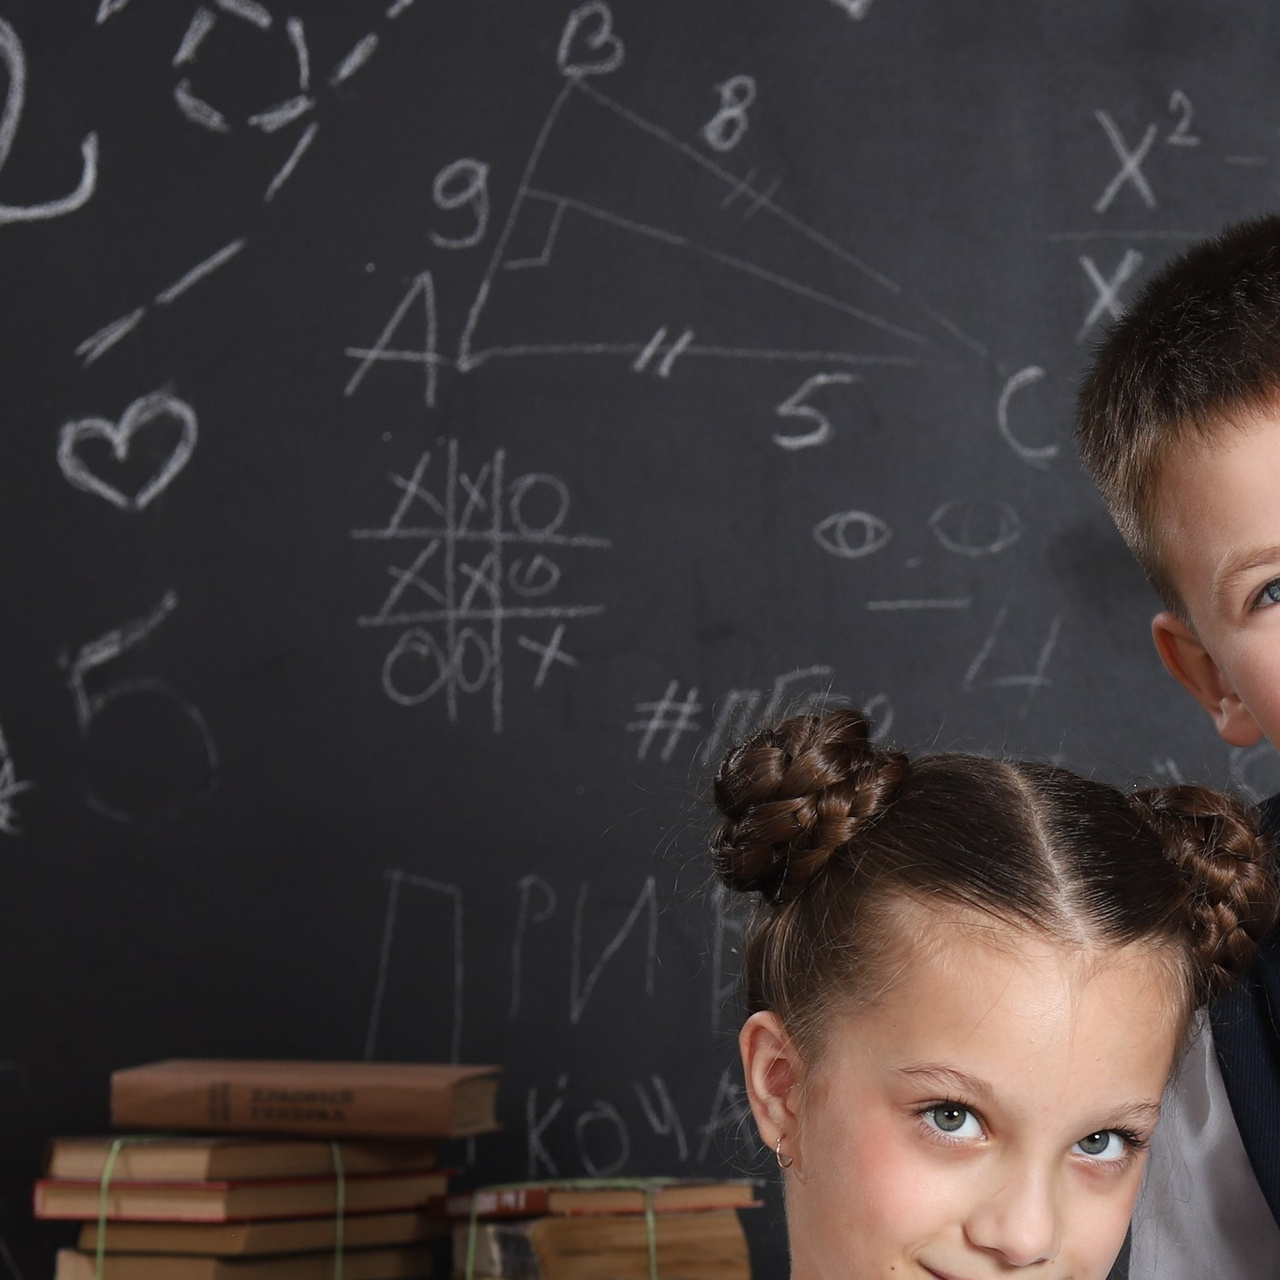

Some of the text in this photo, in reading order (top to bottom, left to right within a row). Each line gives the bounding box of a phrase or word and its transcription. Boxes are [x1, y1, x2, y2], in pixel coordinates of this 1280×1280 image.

[701, 74, 758, 154] 8
[428, 157, 493, 251] 9
[770, 371, 866, 452] 5
